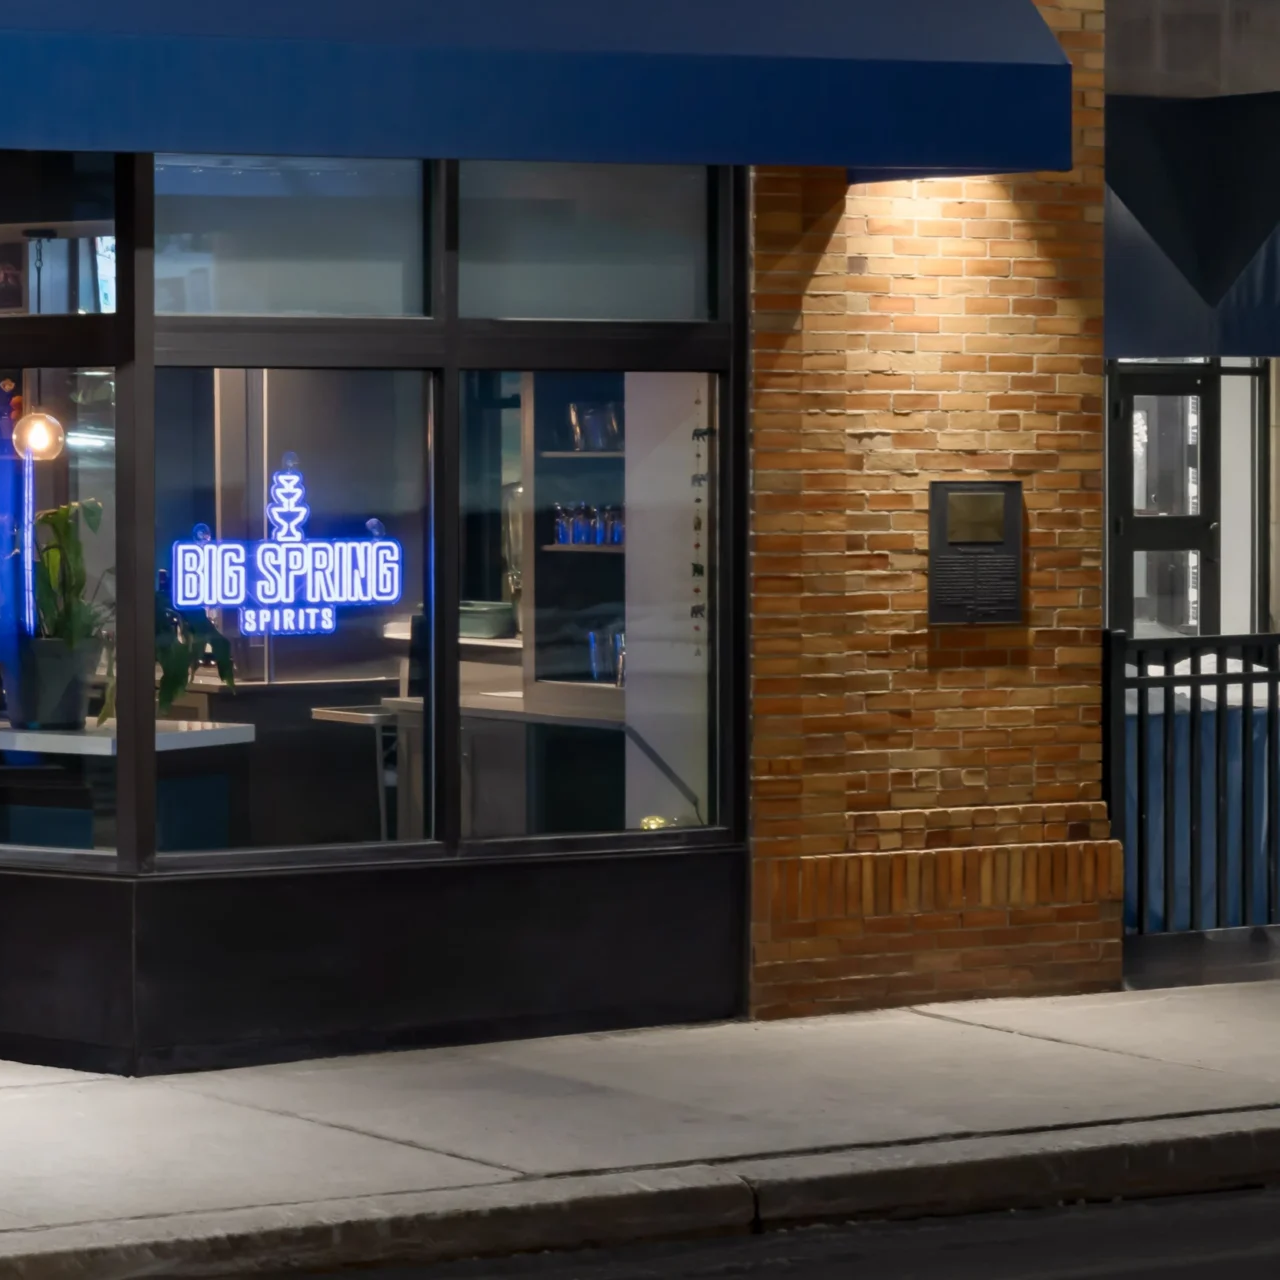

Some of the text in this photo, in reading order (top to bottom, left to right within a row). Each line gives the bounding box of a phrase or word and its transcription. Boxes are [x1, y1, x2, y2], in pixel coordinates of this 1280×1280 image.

[176, 540, 400, 606] BIG SPRING
[243, 607, 334, 633] SPIRITS
